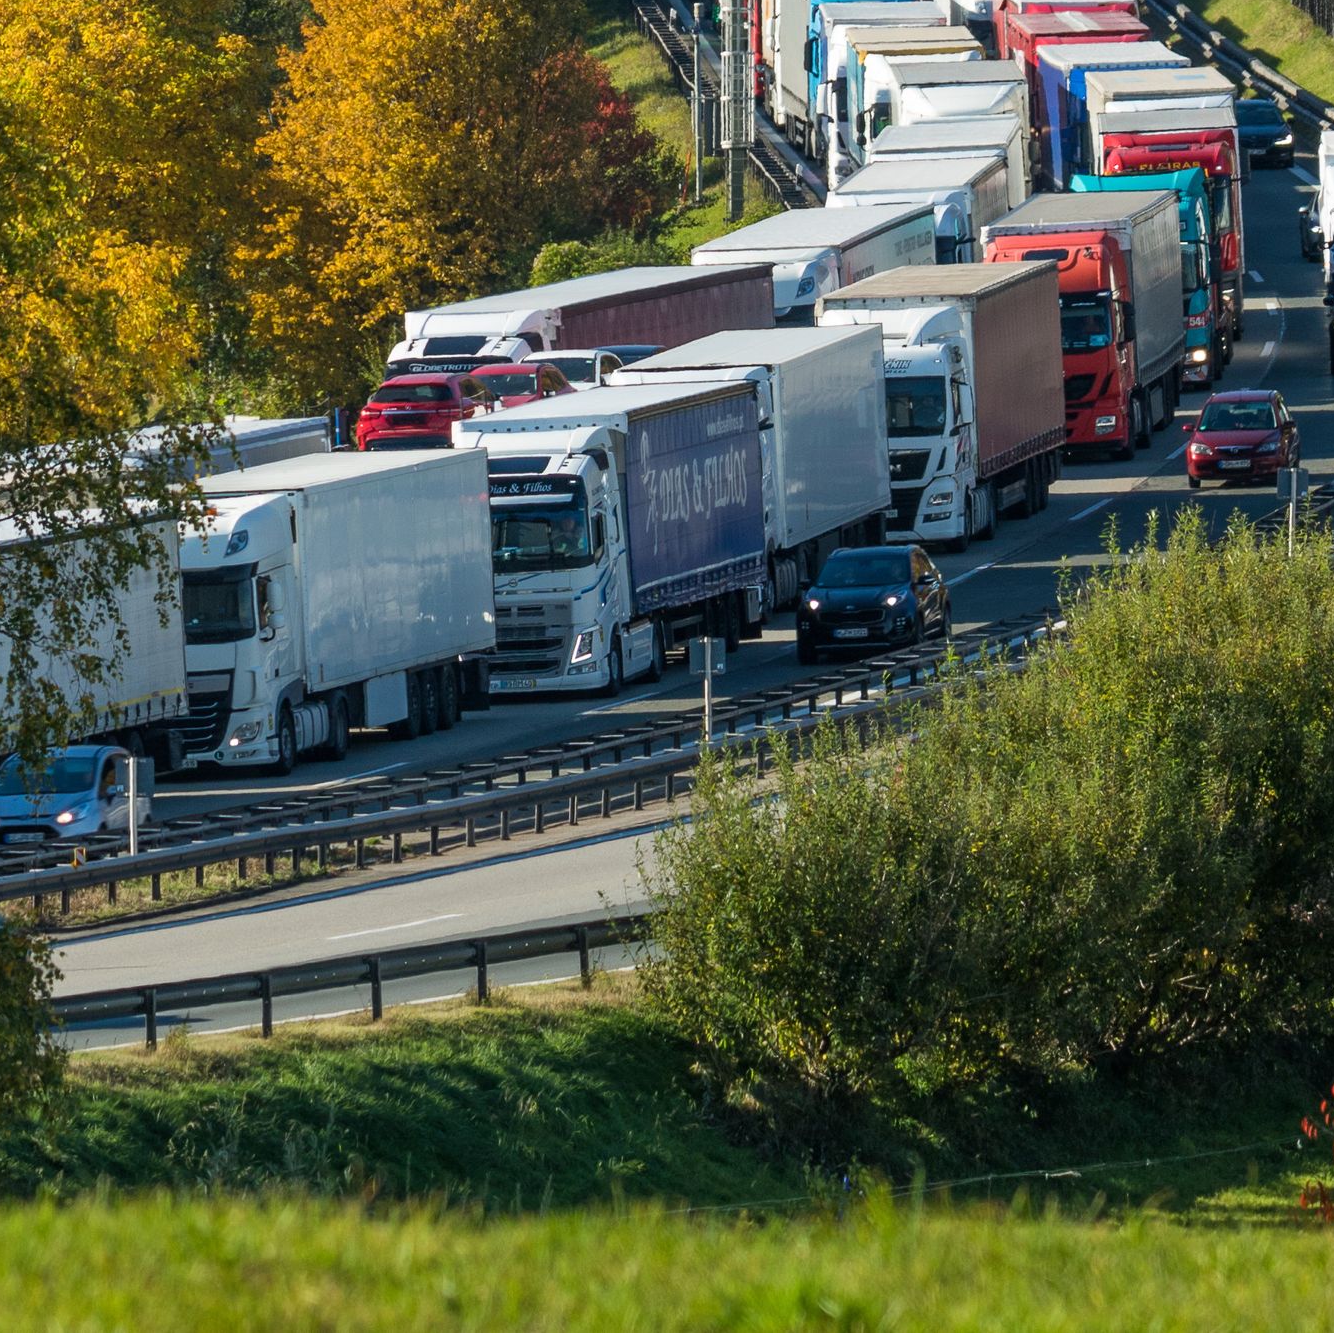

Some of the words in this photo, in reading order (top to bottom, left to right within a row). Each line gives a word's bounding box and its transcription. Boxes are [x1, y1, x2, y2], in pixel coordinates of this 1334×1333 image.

[411, 364, 481, 372] GLOBETROTT
[508, 483, 520, 494] &
[522, 481, 553, 495] Filhos
[692, 458, 704, 514] &
